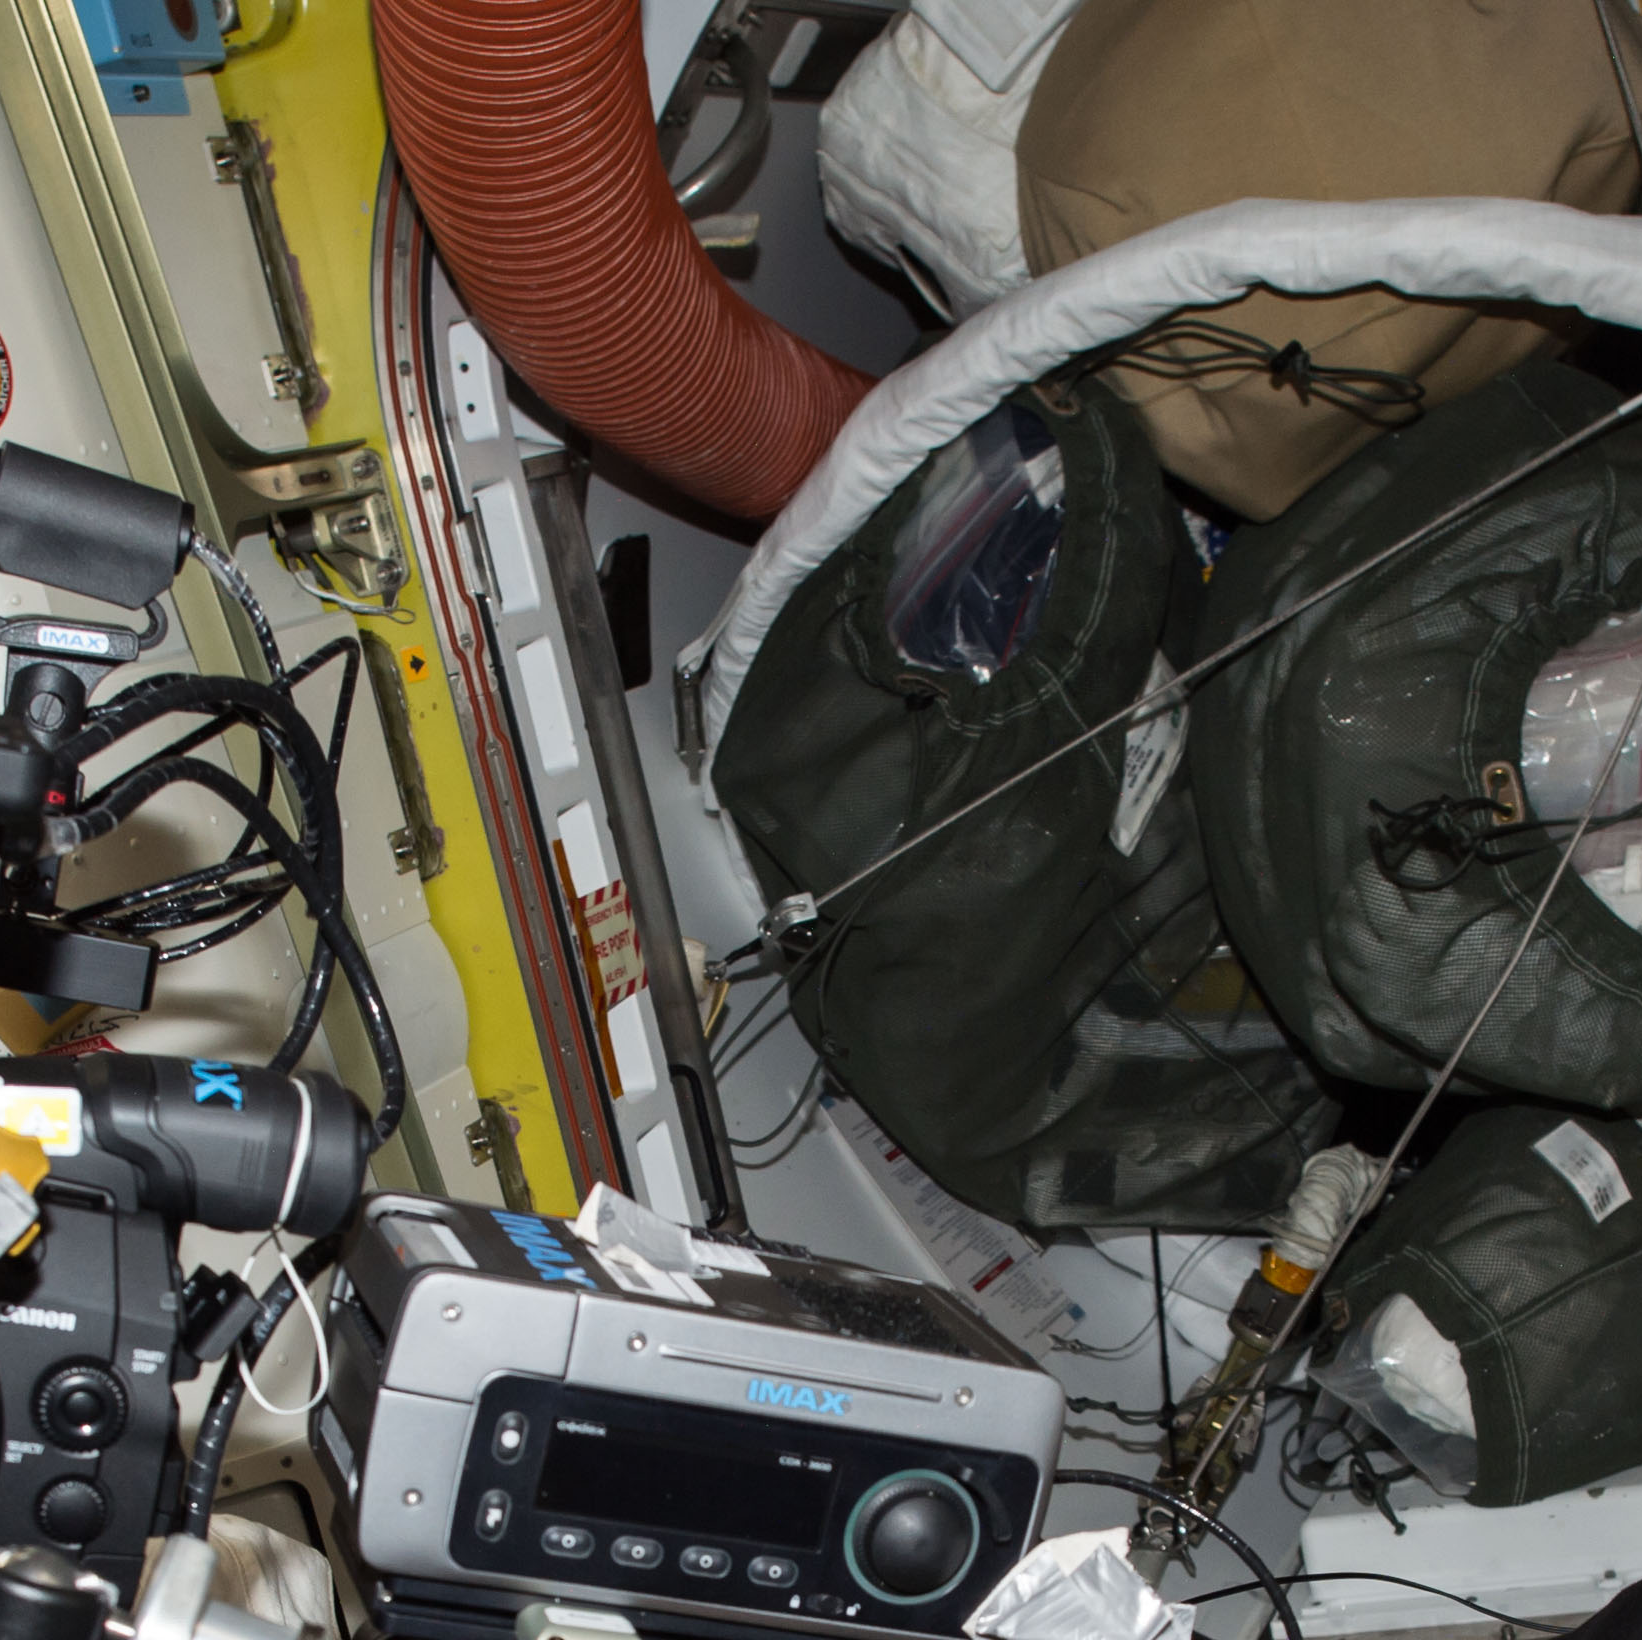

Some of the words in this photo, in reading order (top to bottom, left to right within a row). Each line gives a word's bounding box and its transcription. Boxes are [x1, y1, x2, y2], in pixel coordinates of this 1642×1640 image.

[42, 630, 102, 650] IMAX
[490, 1208, 593, 1288] IMAX
[746, 1378, 847, 1418] IMAX
